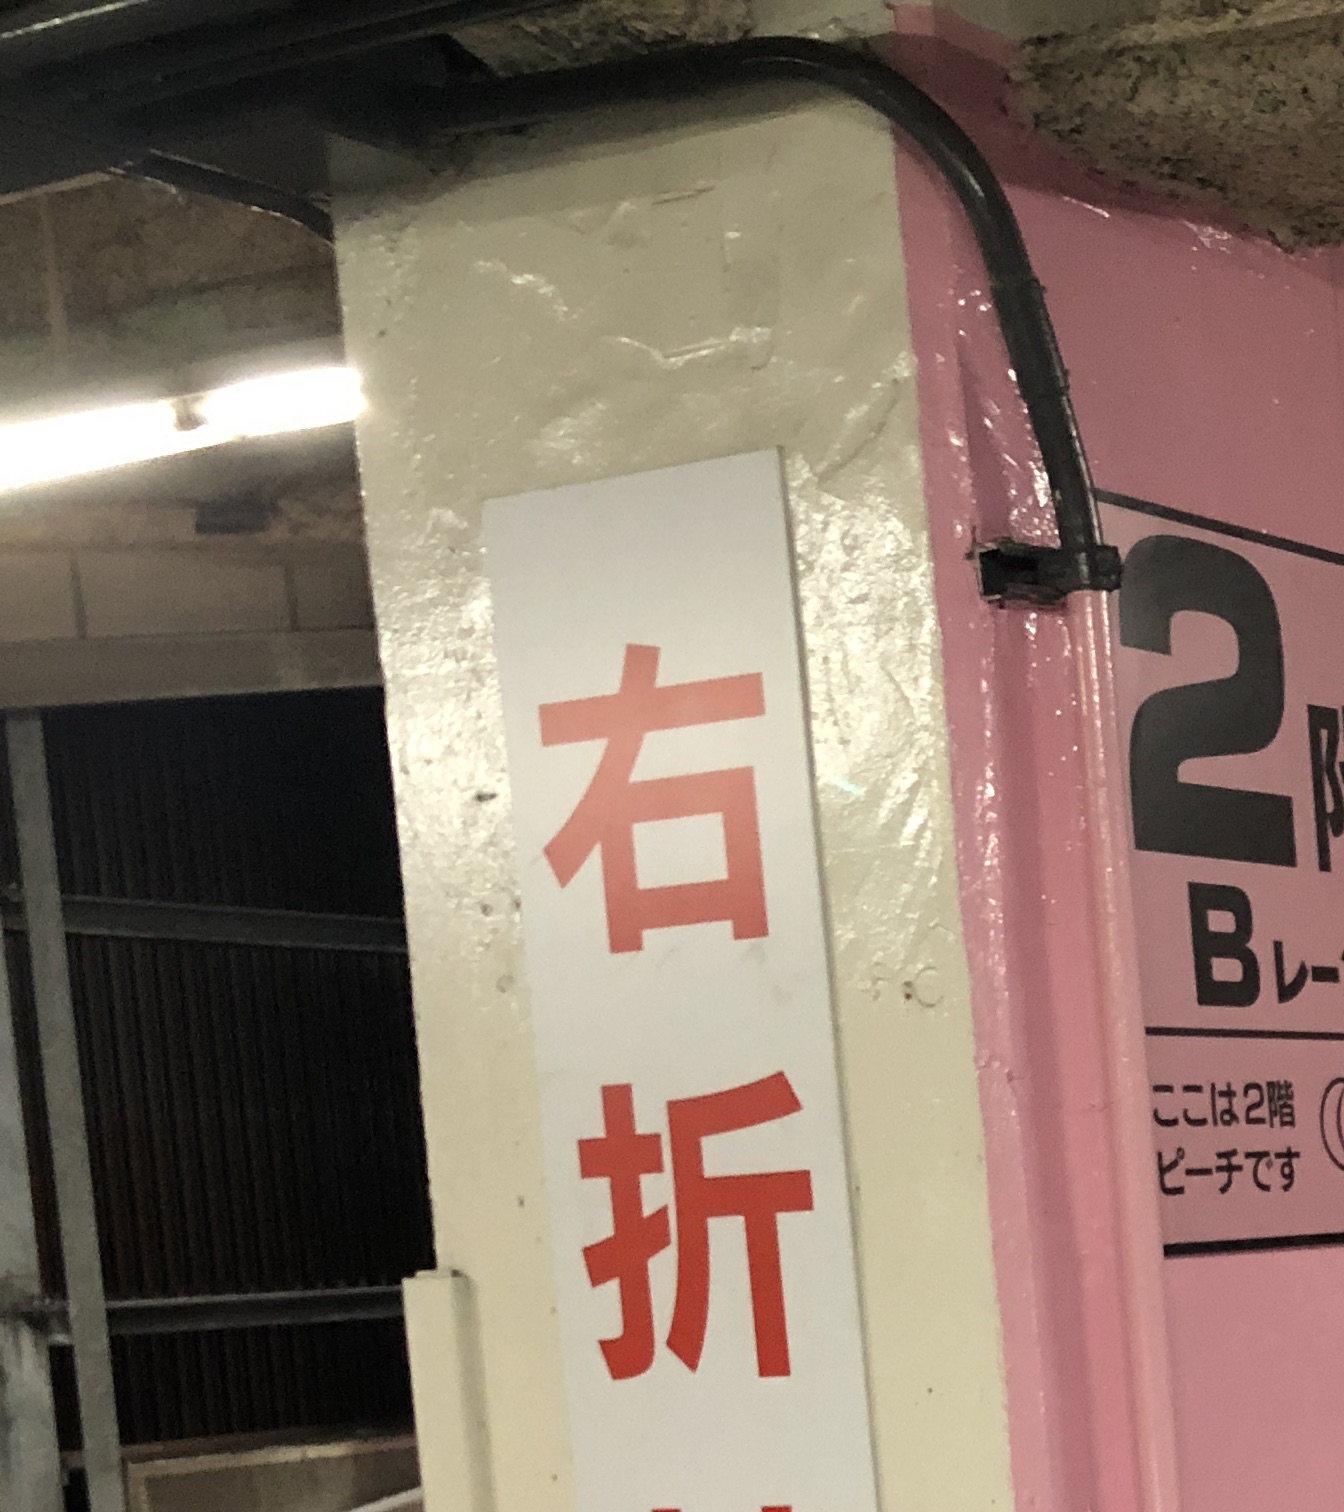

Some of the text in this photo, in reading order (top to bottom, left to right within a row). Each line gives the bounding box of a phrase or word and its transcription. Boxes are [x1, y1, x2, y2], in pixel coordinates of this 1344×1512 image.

[1151, 1080, 1297, 1129] ここは2階
[1156, 1146, 1301, 1196] ピーチです
